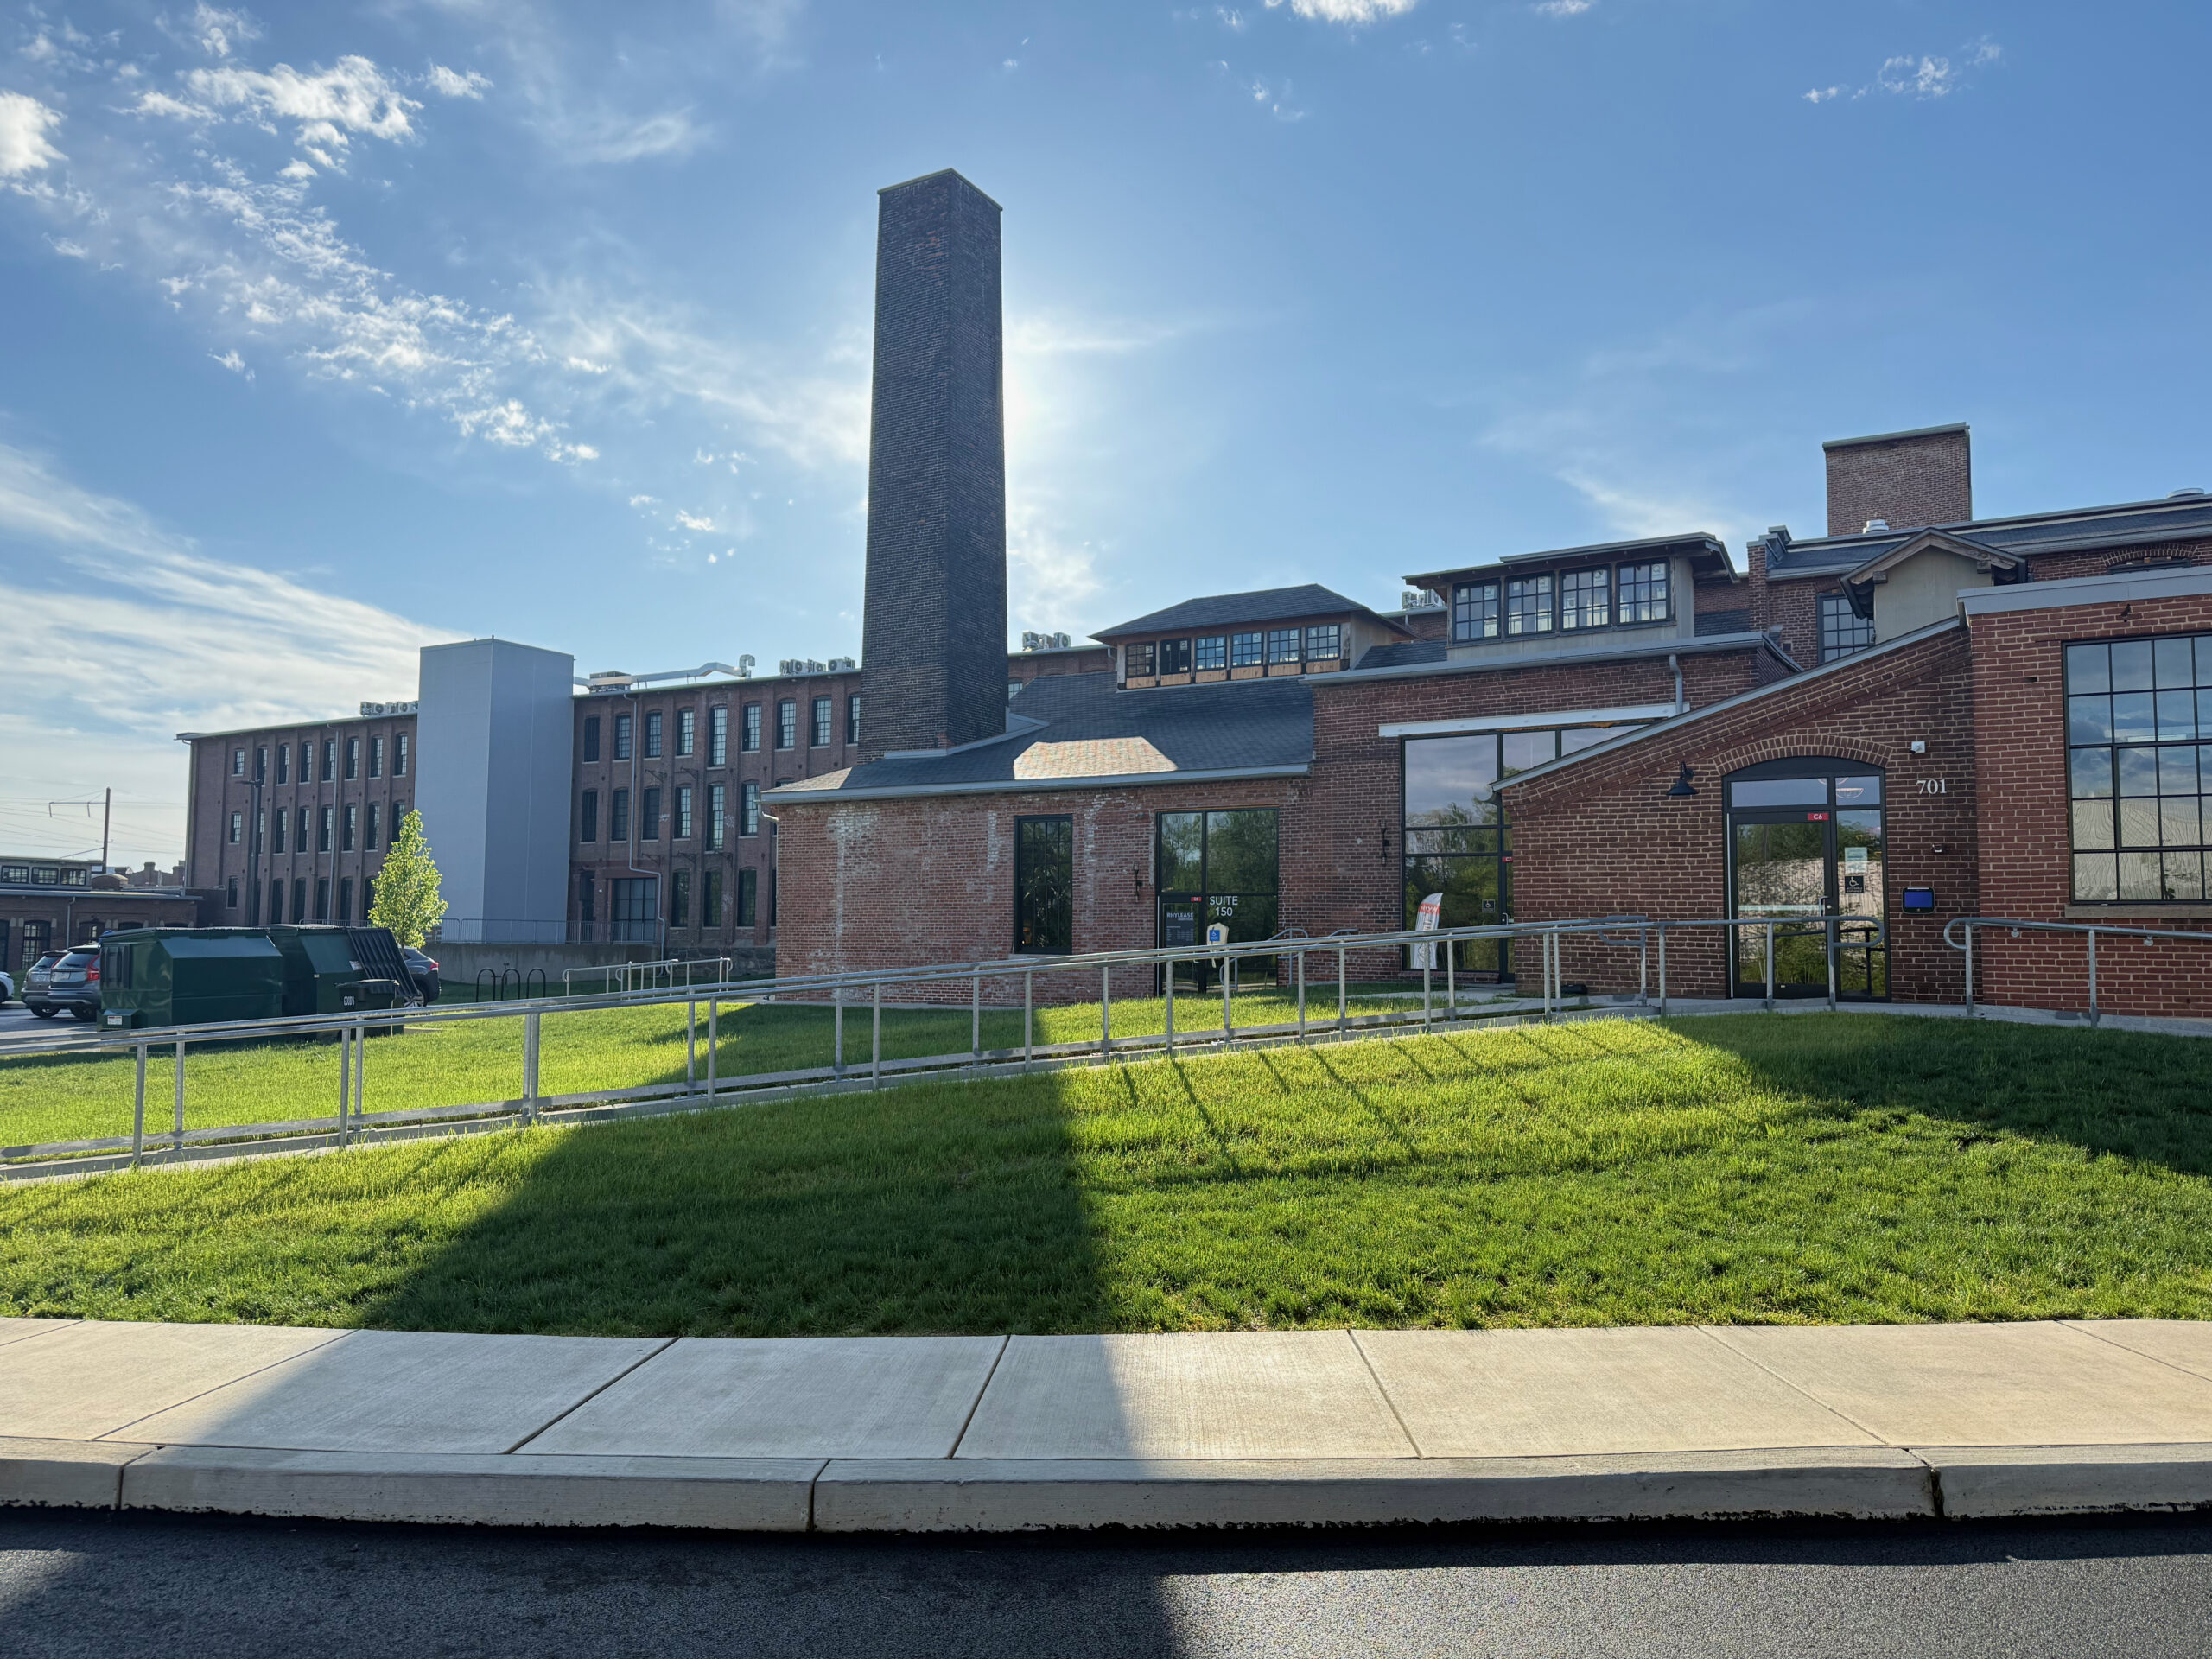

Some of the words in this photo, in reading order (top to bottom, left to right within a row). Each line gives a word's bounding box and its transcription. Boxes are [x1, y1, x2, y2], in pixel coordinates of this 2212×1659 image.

[1916, 779, 1948, 795] 701
[1210, 895, 1238, 906] SUITE
[1216, 906, 1233, 917] 150
